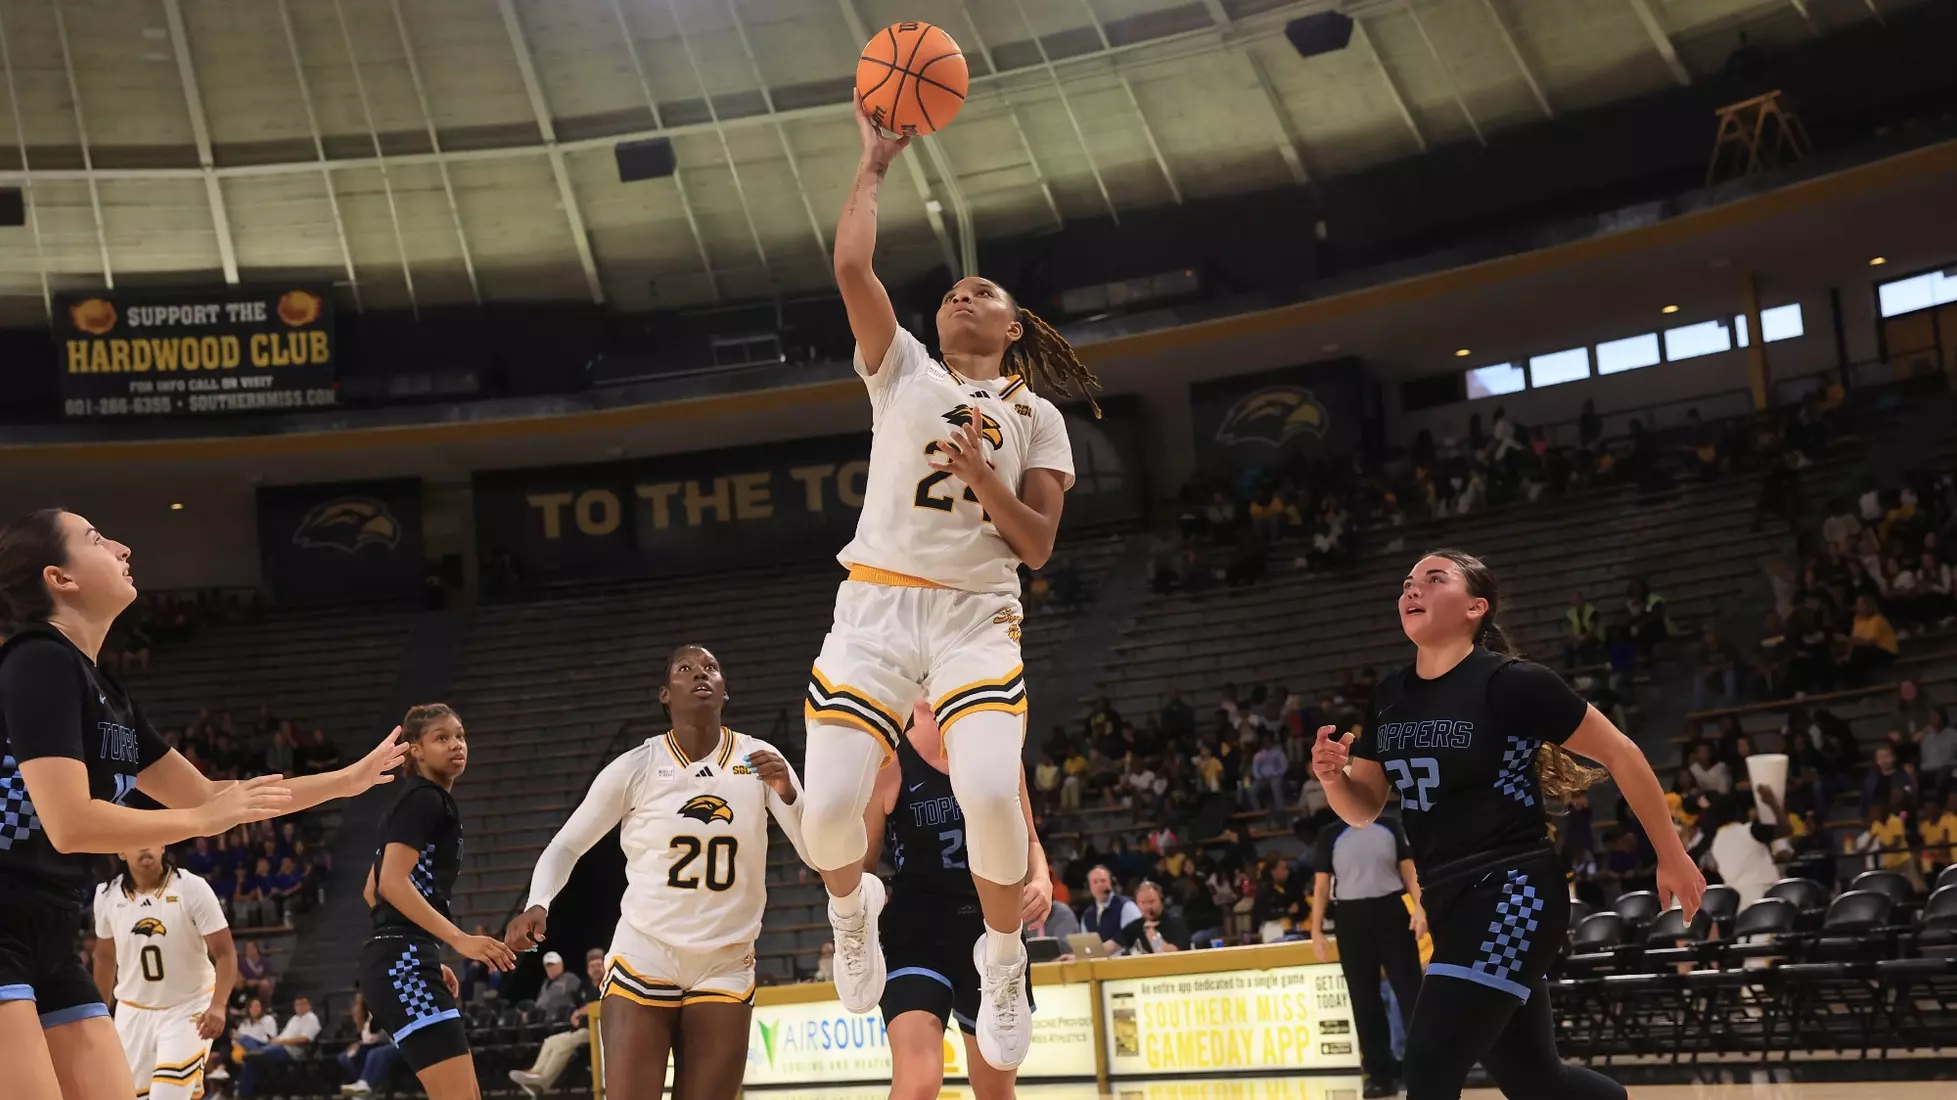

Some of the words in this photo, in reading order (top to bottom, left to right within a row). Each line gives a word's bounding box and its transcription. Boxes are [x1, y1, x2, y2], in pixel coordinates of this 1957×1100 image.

[127, 304, 220, 327] SUPPORT
[225, 302, 267, 322] THE
[66, 336, 240, 374] HARDWOOD
[250, 330, 330, 368] CLUB
[188, 378, 220, 391] CALL
[240, 376, 274, 388] VISIT
[188, 388, 337, 412] SOUTHERNMISS.COM
[526, 489, 622, 539] TO
[635, 472, 775, 529] THE
[789, 460, 869, 512] TO
[1377, 719, 1473, 753] OPPERS
[1384, 757, 1440, 812] 22
[667, 835, 738, 892] 20
[140, 944, 165, 982] 0
[1141, 982, 1151, 994] An
[1153, 981, 1175, 993] entire
[1178, 982, 1192, 994] app
[1194, 977, 1234, 992] dedicated
[1235, 977, 1244, 988] to
[1247, 978, 1253, 988] a
[1254, 975, 1278, 990] single
[1281, 974, 1305, 988] game
[1316, 975, 1333, 991] GET
[1336, 974, 1346, 990] IT
[1144, 995, 1249, 1029] SOUTHERN
[1256, 992, 1309, 1023] MISS
[1316, 993, 1347, 1010] TODAY
[854, 1057, 891, 1070] HEATIN
[1145, 1028, 1254, 1069] GAMEDAY
[1263, 1025, 1310, 1065] APP
